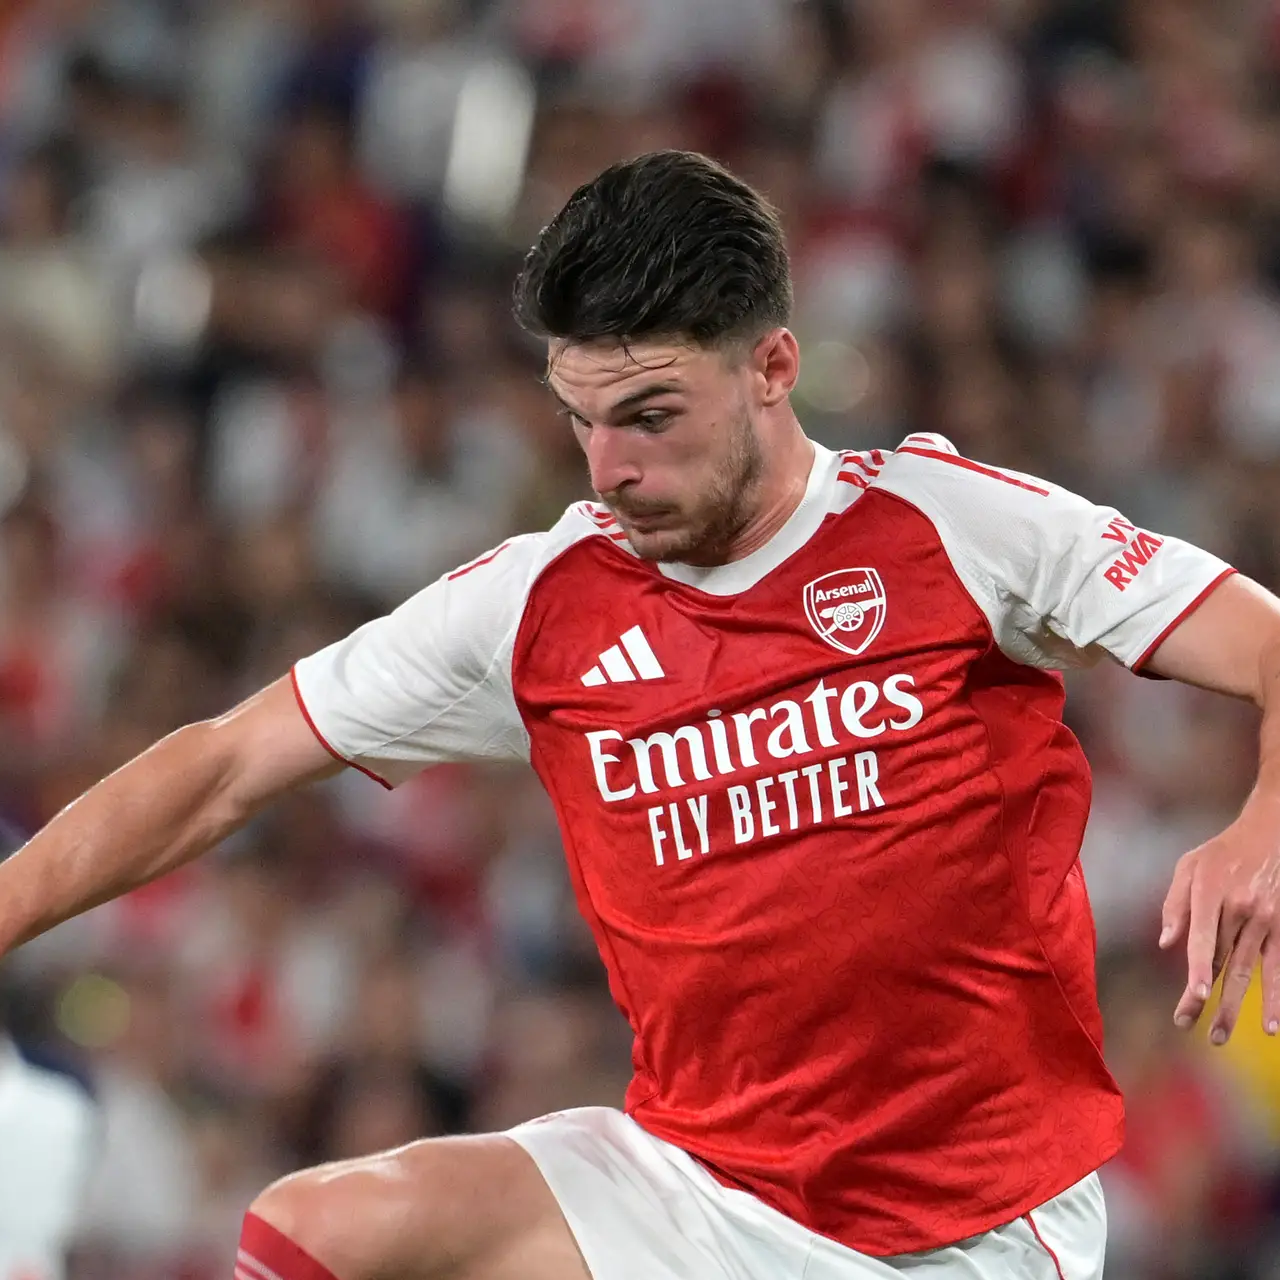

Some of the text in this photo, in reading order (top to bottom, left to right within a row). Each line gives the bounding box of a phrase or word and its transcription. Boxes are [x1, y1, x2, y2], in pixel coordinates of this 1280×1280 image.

[815, 578, 872, 603] Arsenal
[584, 673, 924, 803] Emirates
[647, 750, 886, 866] FLY BETTER
